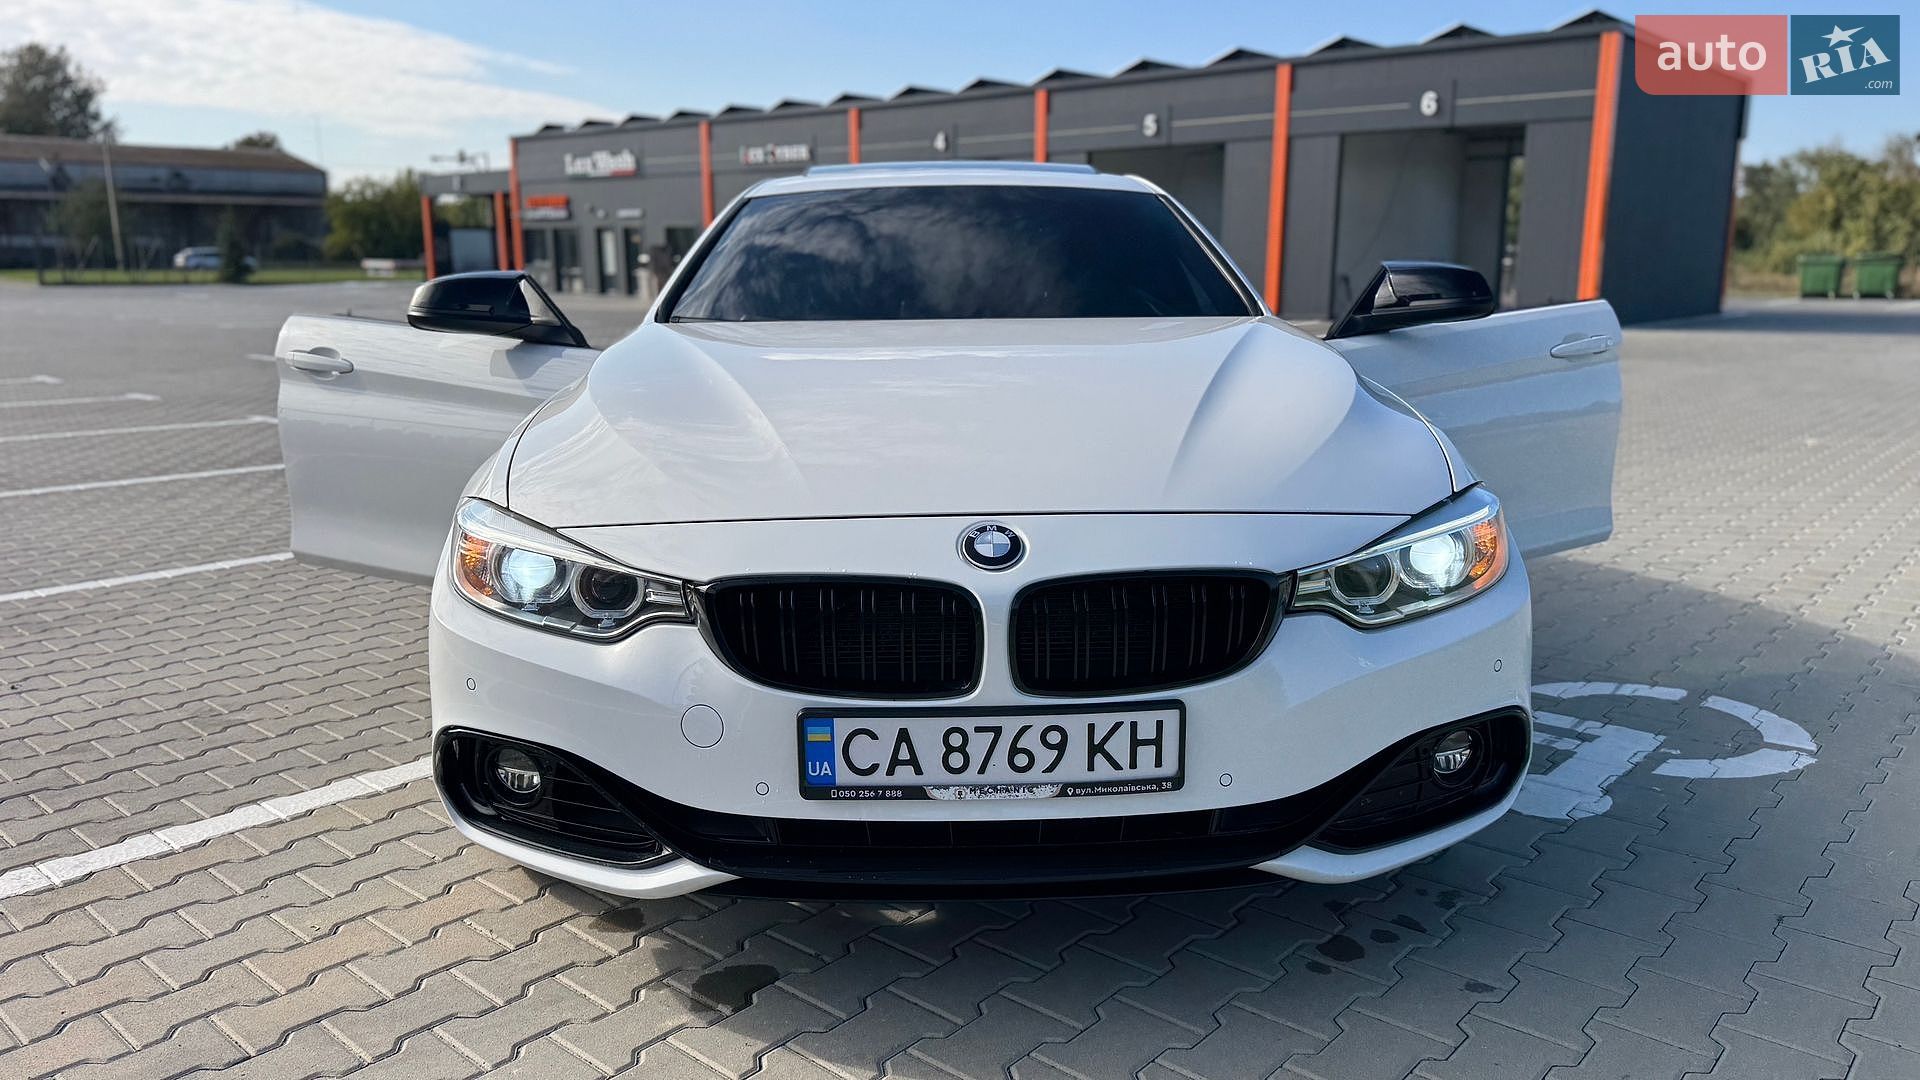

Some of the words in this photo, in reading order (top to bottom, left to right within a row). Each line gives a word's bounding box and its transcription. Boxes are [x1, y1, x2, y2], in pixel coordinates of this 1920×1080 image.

[1421, 90, 1438, 116] 6
[1142, 114, 1158, 136] 5
[933, 131, 946, 152] 4
[969, 525, 1016, 538] BMW
[841, 726, 924, 777] CA
[941, 723, 1069, 776] 8769
[1087, 719, 1164, 773] KH
[807, 761, 833, 777] UA
[838, 790, 856, 798] 050
[858, 790, 875, 798] 256
[885, 790, 903, 798] 888
[1161, 781, 1173, 790] 38
